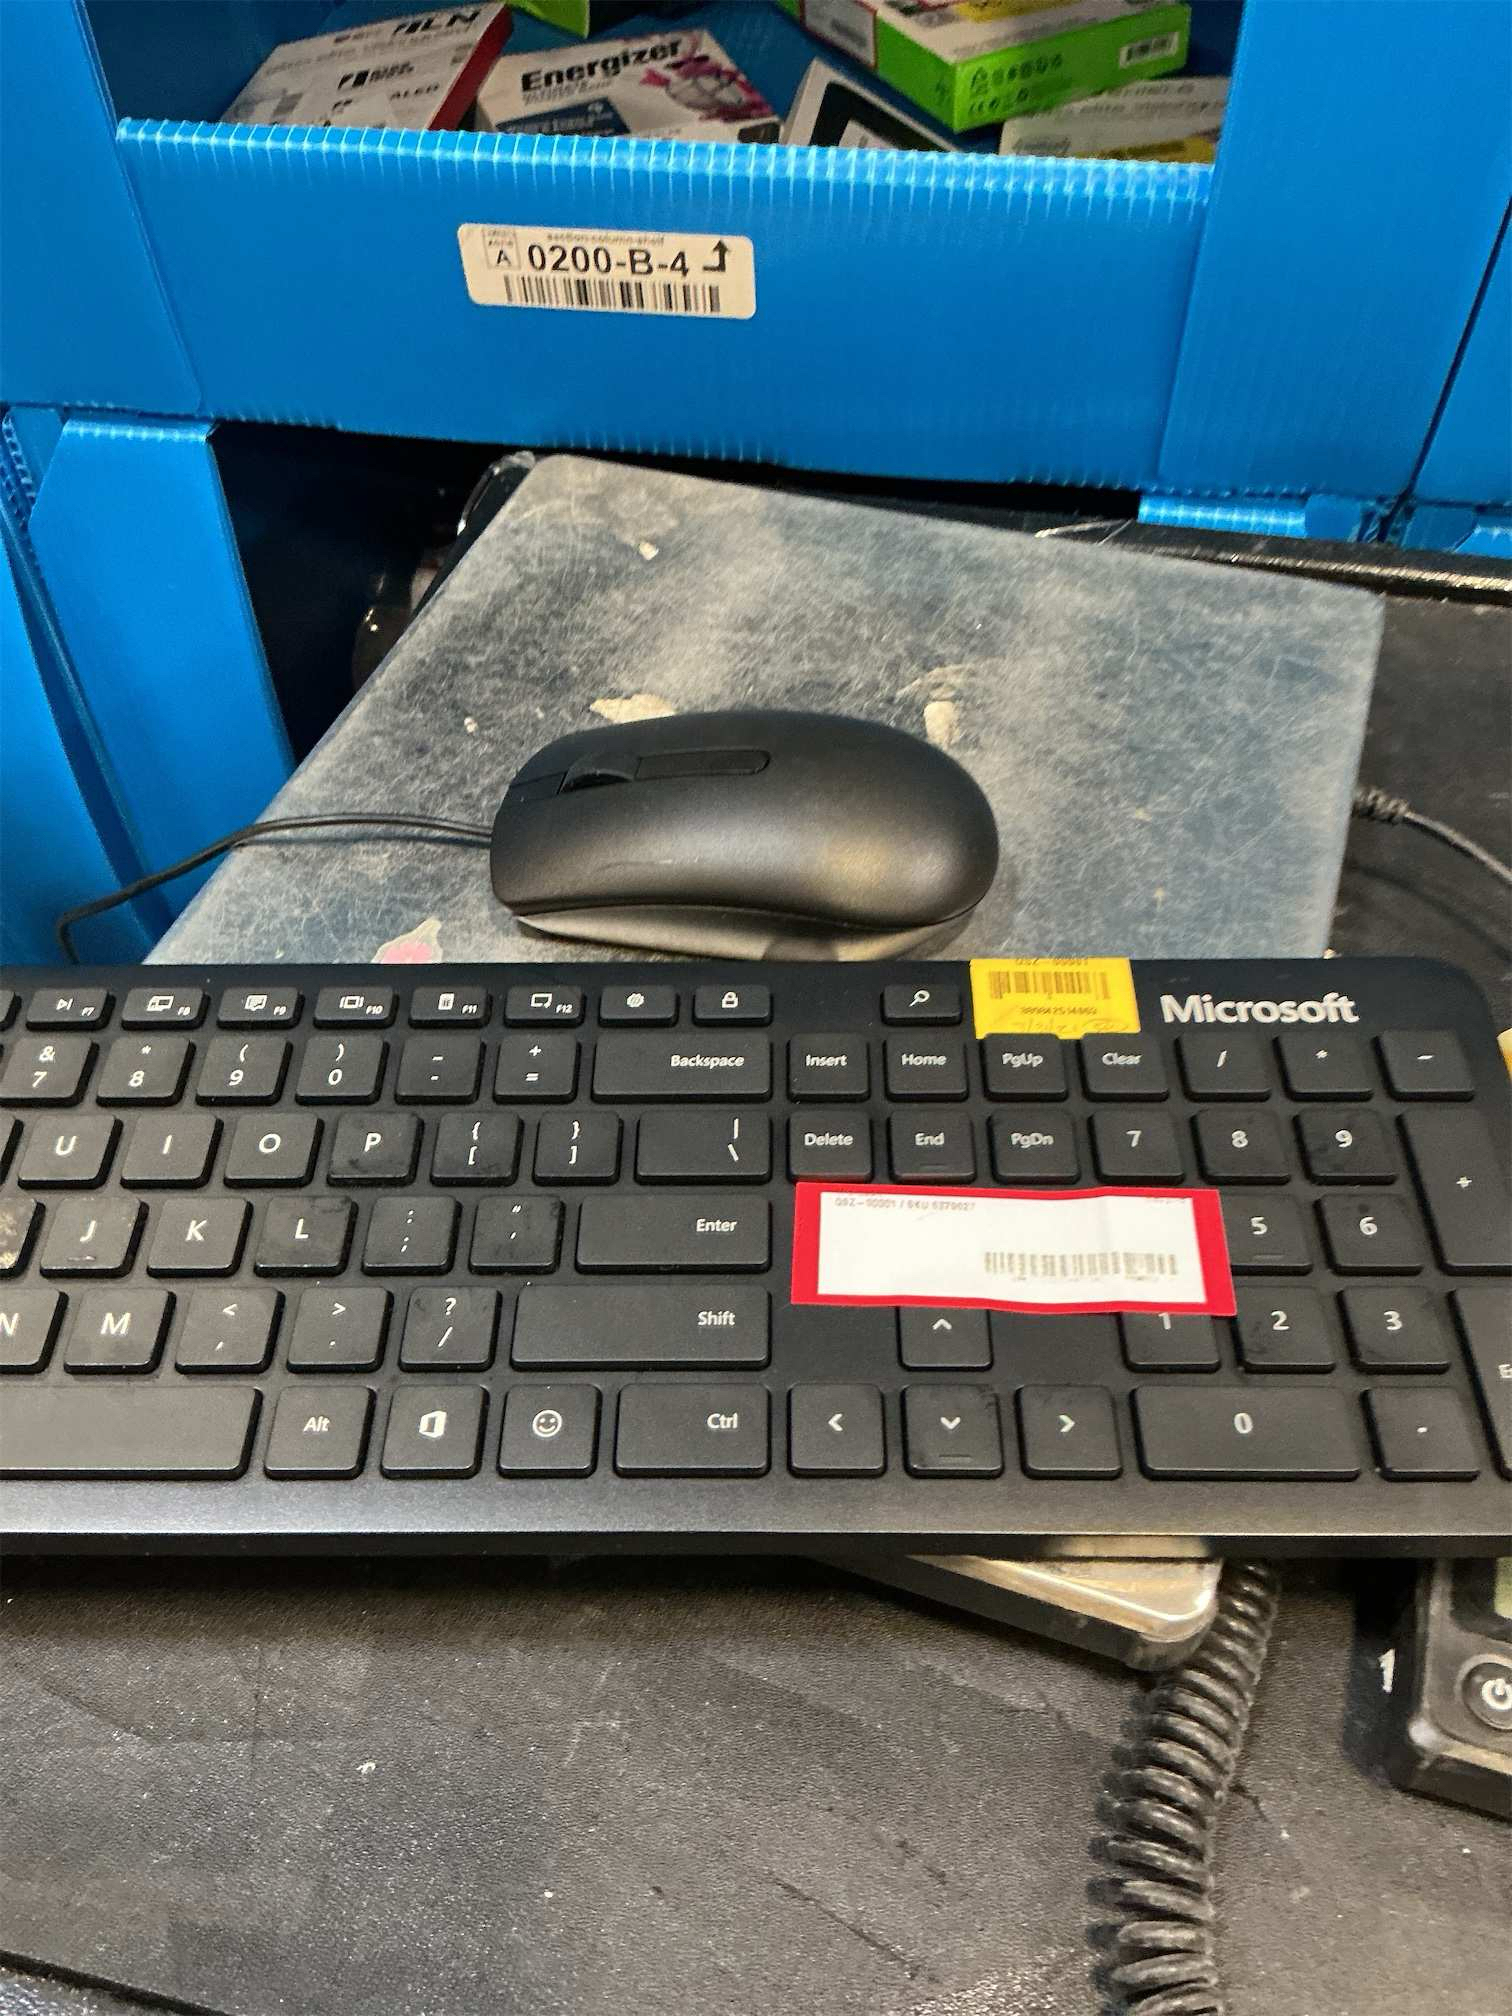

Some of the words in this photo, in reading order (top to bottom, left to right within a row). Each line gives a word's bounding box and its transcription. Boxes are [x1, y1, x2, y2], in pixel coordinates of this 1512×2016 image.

[522, 39, 682, 92] Energizer
[496, 249, 512, 267] A
[528, 244, 690, 276] 0200-B-4
[82, 1007, 94, 1016] F7
[274, 1006, 286, 1015] F9
[366, 1006, 383, 1015] F10
[462, 1005, 477, 1013] F11
[556, 1005, 572, 1013] F12
[1160, 992, 1360, 1023] Microsoft
[39, 1046, 55, 1062] &
[239, 1044, 249, 1063] (
[335, 1043, 345, 1062] )
[529, 1046, 541, 1056] +
[902, 1054, 946, 1065] Home
[1102, 1053, 1141, 1065] Clear
[1217, 1051, 1227, 1067] /
[671, 1055, 744, 1069] Backspace
[806, 1055, 847, 1066] Insert
[1003, 1053, 1043, 1067] PgUp
[32, 1071, 47, 1087] 7
[128, 1071, 144, 1087] 8
[229, 1070, 243, 1086] 9
[328, 1069, 342, 1085] 0
[525, 1073, 539, 1082] =
[471, 1121, 481, 1141] {
[571, 1120, 580, 1140] }
[1336, 1130, 1352, 1147] 9
[55, 1136, 77, 1155] U
[162, 1134, 173, 1155] I
[259, 1134, 281, 1153] O
[364, 1133, 381, 1152] P
[805, 1133, 853, 1145] Delete
[916, 1133, 944, 1145] End
[1011, 1133, 1053, 1148] PgDn
[1127, 1131, 1141, 1147] 7
[1232, 1131, 1248, 1148] 8
[468, 1145, 478, 1166] [
[568, 1145, 578, 1165] ]
[1457, 1177, 1472, 1188] +
[80, 1220, 97, 1242] J
[186, 1220, 207, 1241] K
[295, 1219, 308, 1239] L
[697, 1219, 737, 1232] Enter
[1251, 1217, 1267, 1234] 5
[1360, 1217, 1377, 1235] 6
[223, 1304, 237, 1316] <
[332, 1303, 345, 1315] >
[446, 1298, 456, 1315] ?
[0, 1313, 19, 1336] N
[101, 1313, 131, 1336] M
[698, 1311, 735, 1325] Shift
[1156, 1312, 1171, 1329] 1
[1272, 1311, 1289, 1330] 2
[1384, 1311, 1402, 1330] 3
[438, 1327, 453, 1347] /
[303, 1416, 329, 1432] Alt
[707, 1413, 738, 1430] Ctrl
[1234, 1413, 1253, 1433] 0
